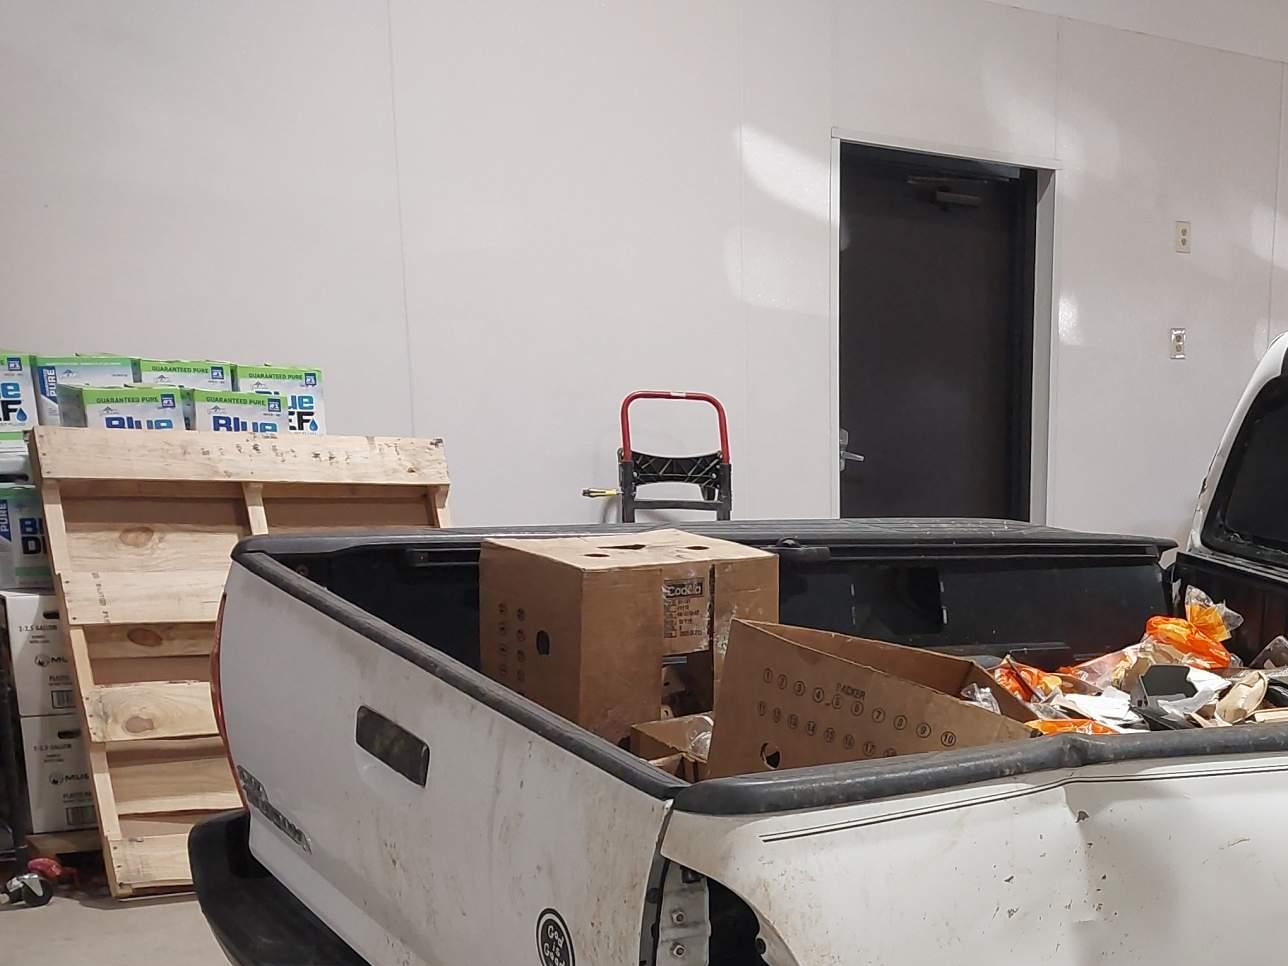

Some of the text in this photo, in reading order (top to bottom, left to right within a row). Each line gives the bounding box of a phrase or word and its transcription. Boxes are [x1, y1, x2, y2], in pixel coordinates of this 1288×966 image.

[151, 366, 192, 374] GUARANTEED
[47, 369, 57, 397] PURE
[96, 396, 140, 404] GUARANTEED
[206, 397, 248, 405] GUARANTEED
[548, 925, 565, 948] God
[552, 941, 560, 957] is
